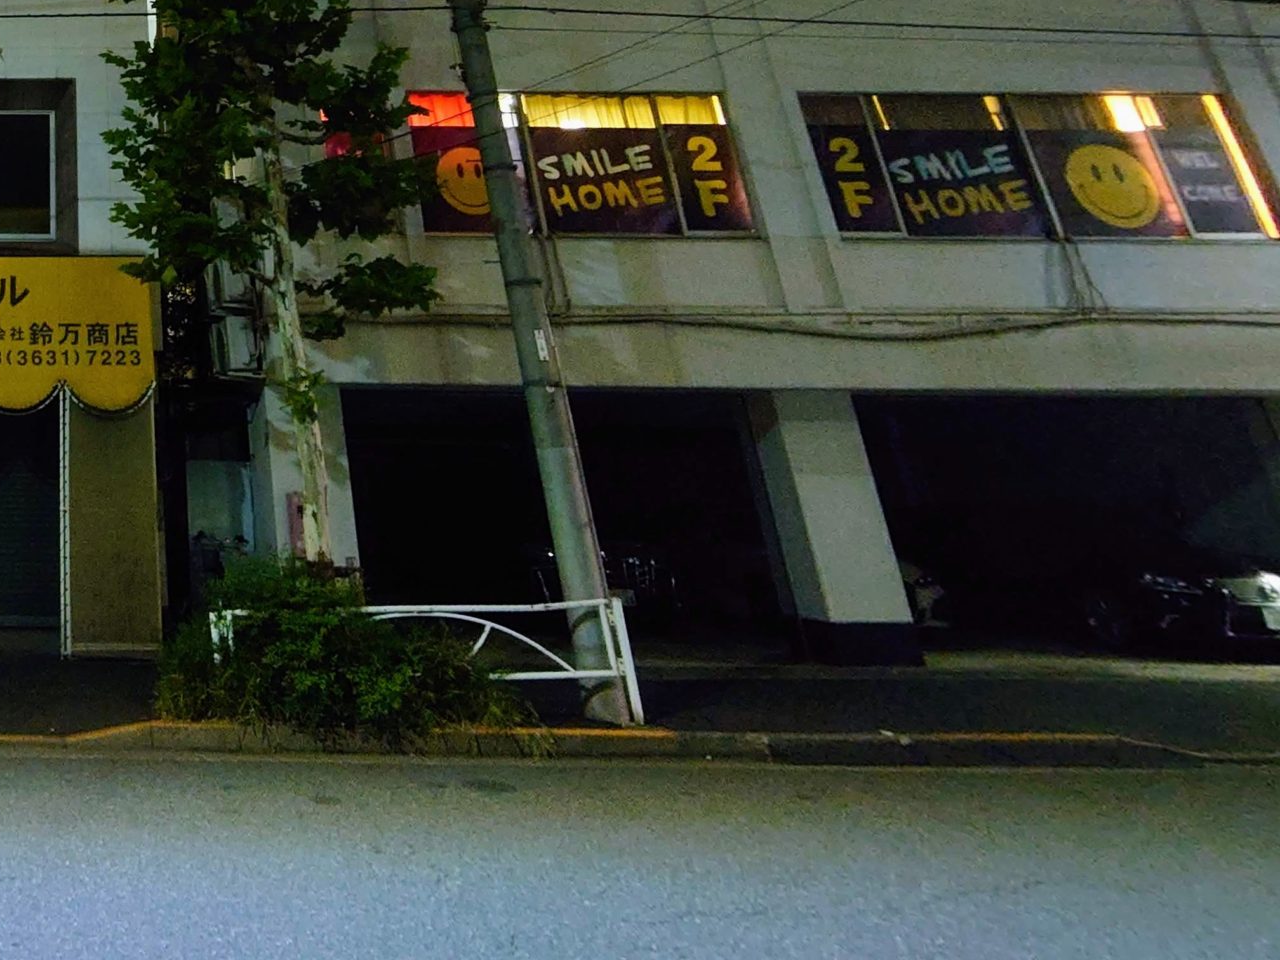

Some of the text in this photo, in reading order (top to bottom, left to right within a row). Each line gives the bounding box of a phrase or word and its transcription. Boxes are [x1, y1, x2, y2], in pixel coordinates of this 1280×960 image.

[537, 144, 653, 181] SMILE
[888, 144, 1015, 184] SMILE
[548, 176, 667, 217] HOME
[902, 179, 1034, 225] HOME
